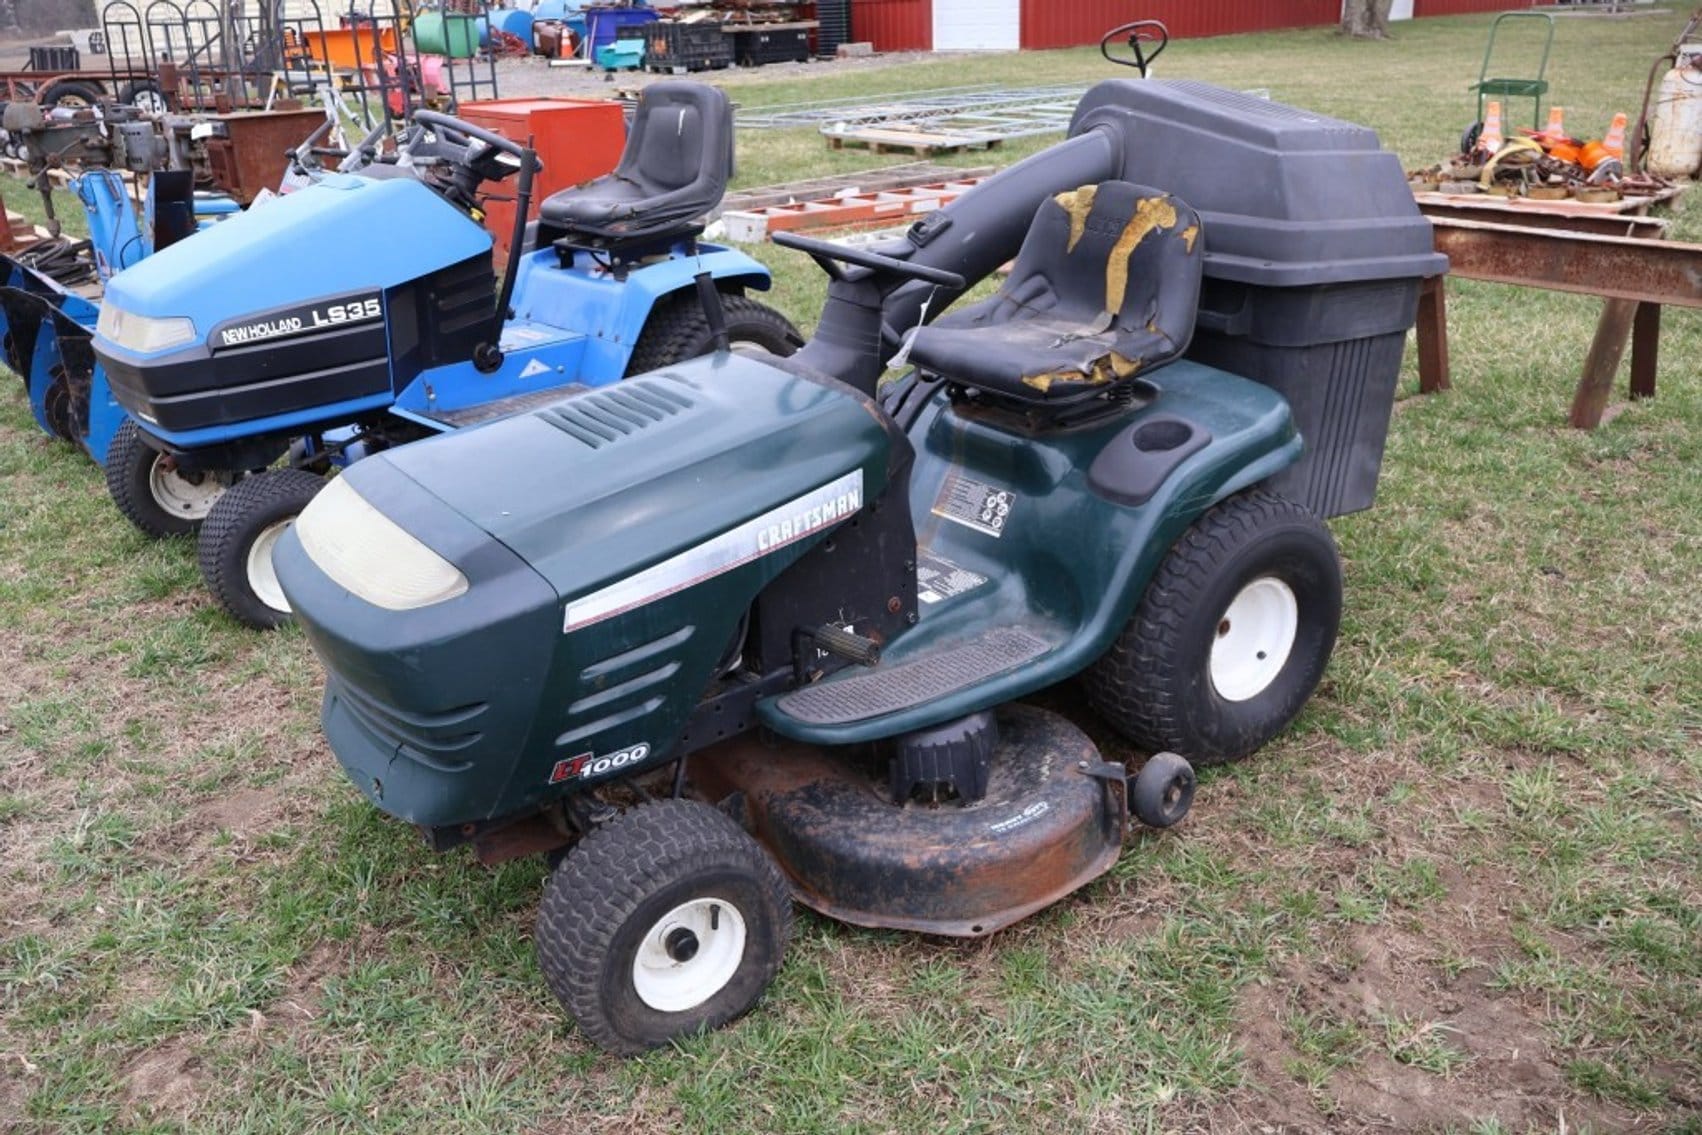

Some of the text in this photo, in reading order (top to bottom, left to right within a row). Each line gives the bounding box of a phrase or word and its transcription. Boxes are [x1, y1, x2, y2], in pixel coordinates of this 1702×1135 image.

[221, 298, 381, 345] NEW HOLLAND LS35
[757, 489, 860, 551] CRAFTSMAN
